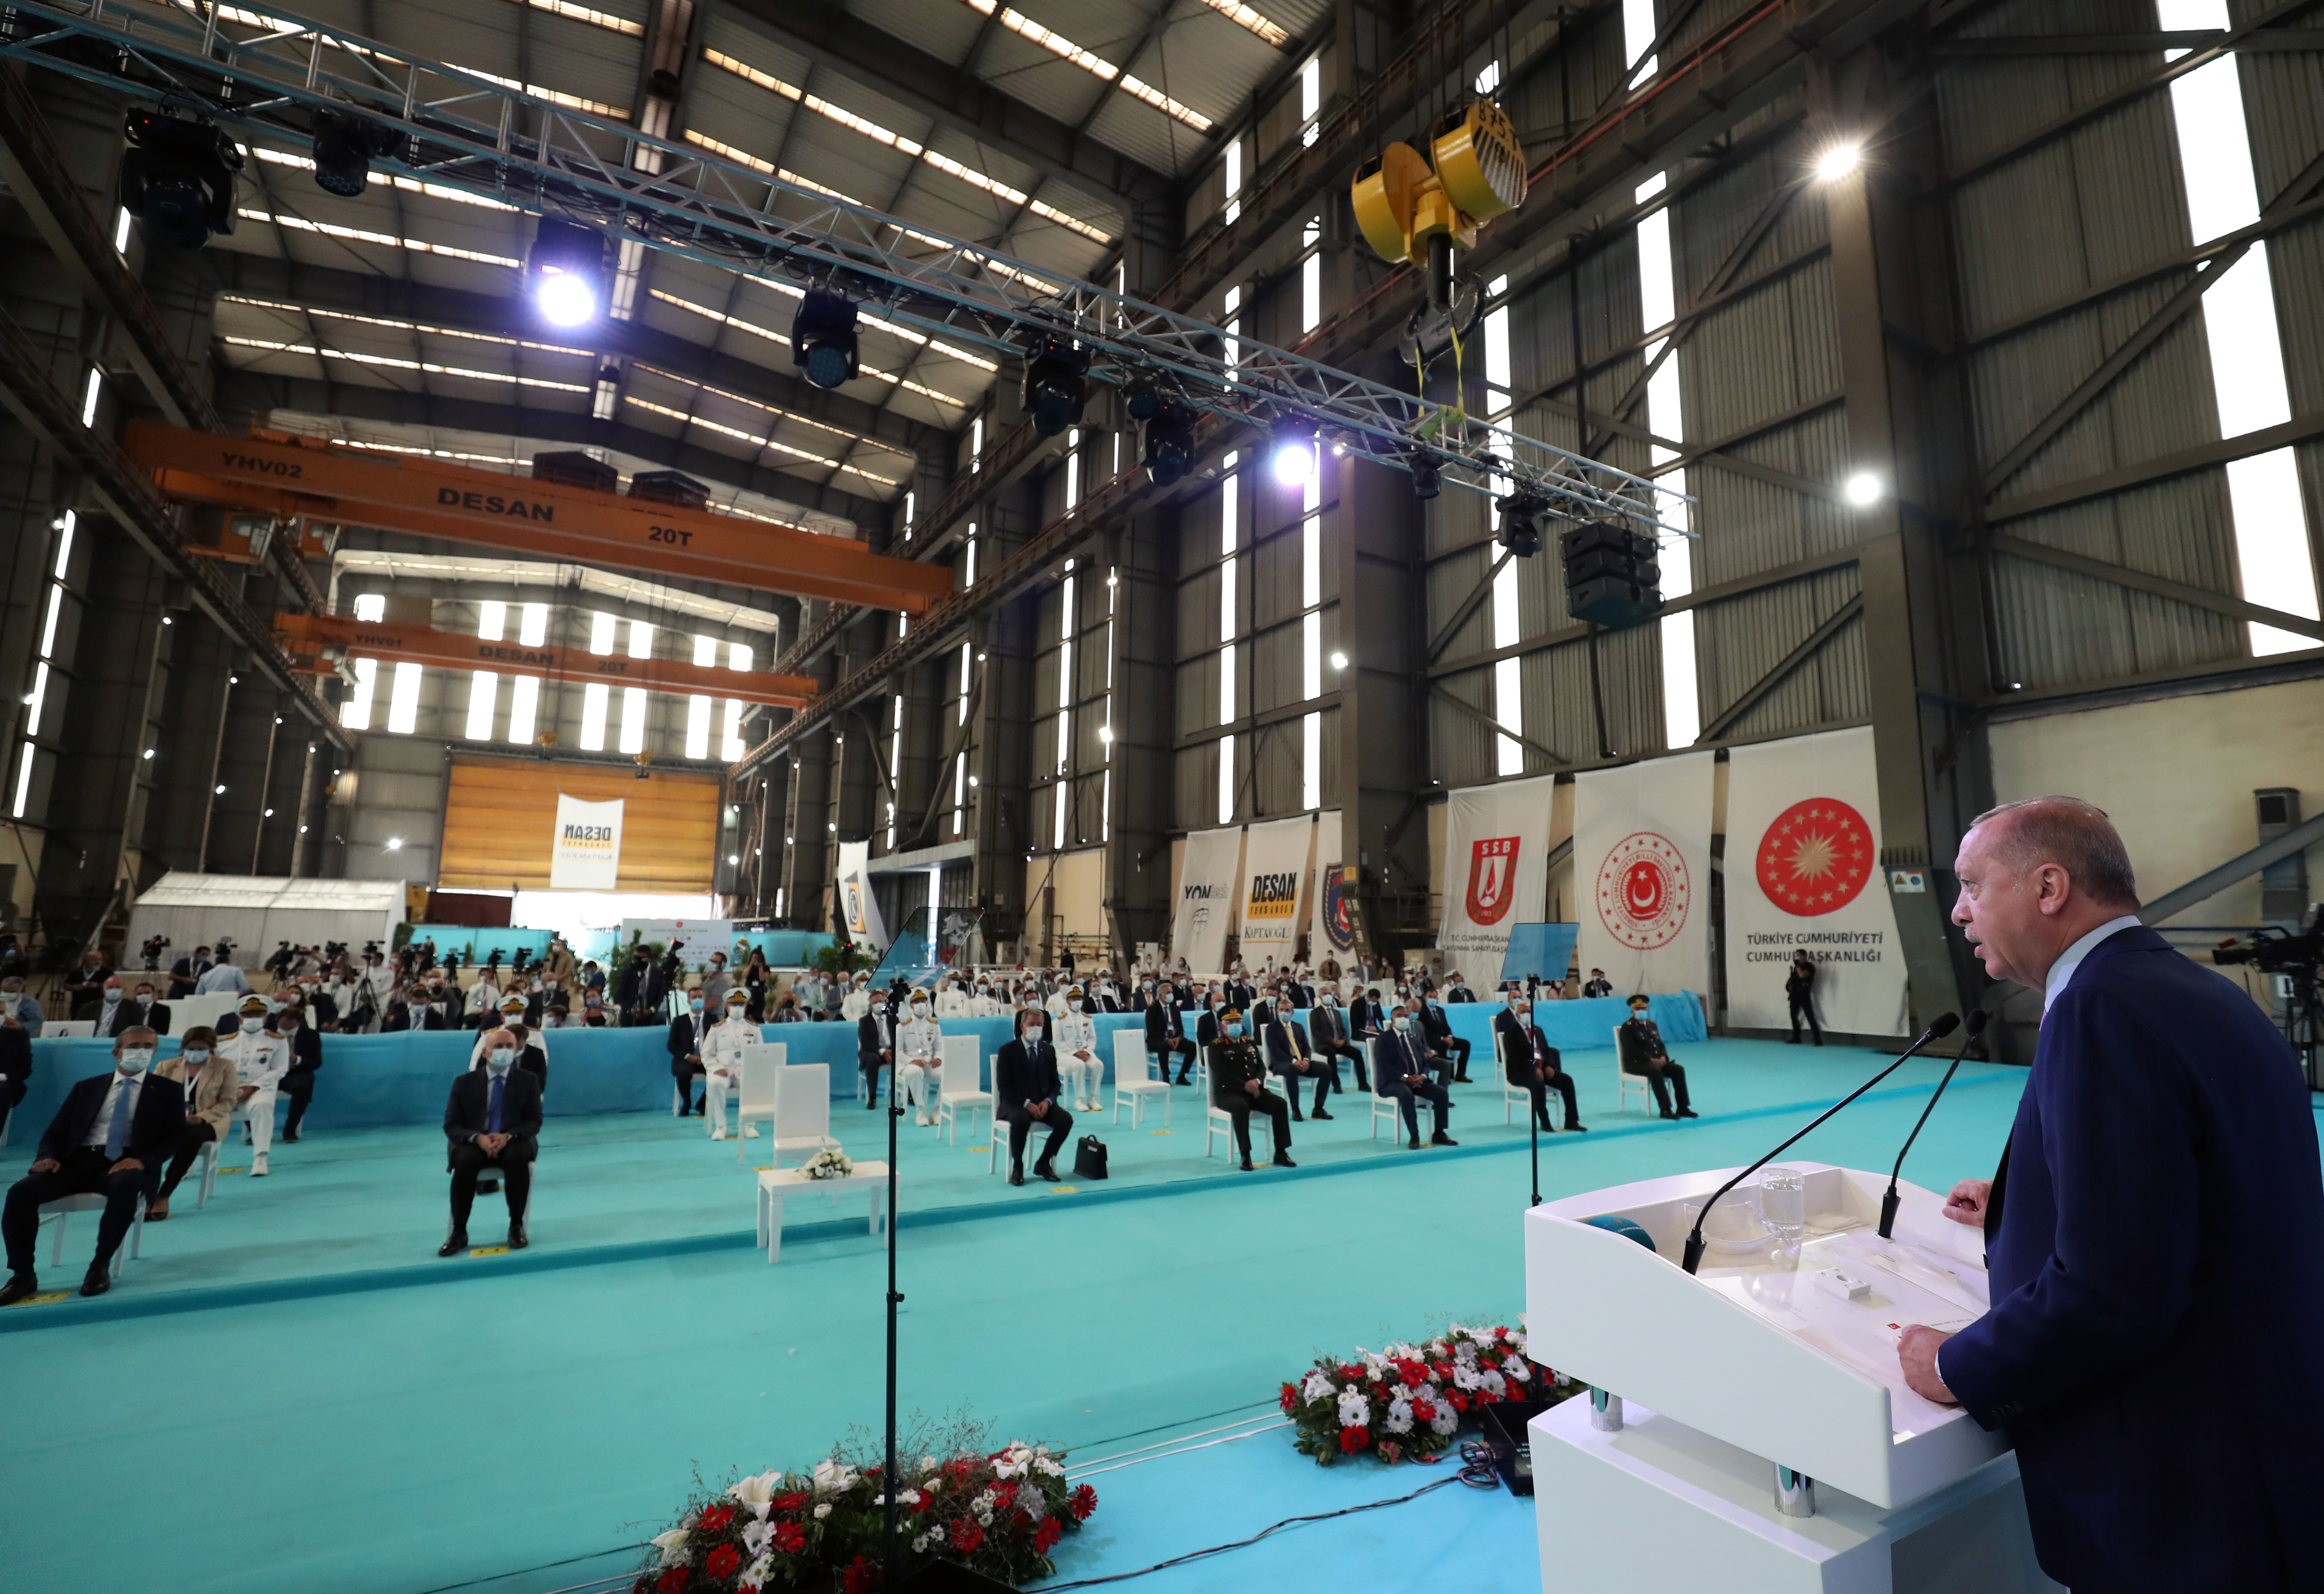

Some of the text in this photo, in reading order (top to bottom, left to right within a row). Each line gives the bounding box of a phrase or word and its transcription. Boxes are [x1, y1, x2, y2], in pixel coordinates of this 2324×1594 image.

[222, 452, 302, 479] YHV02
[437, 487, 553, 522] DESAN
[648, 526, 692, 546] 20T
[479, 646, 553, 664] DESAN
[597, 661, 627, 672] 20T
[1252, 872, 1297, 903] DESAN
[1747, 930, 1883, 945] TÜRKİYE CUMHURİYETİ
[1747, 949, 1881, 964] CUMHUAŞKANLIĞI
